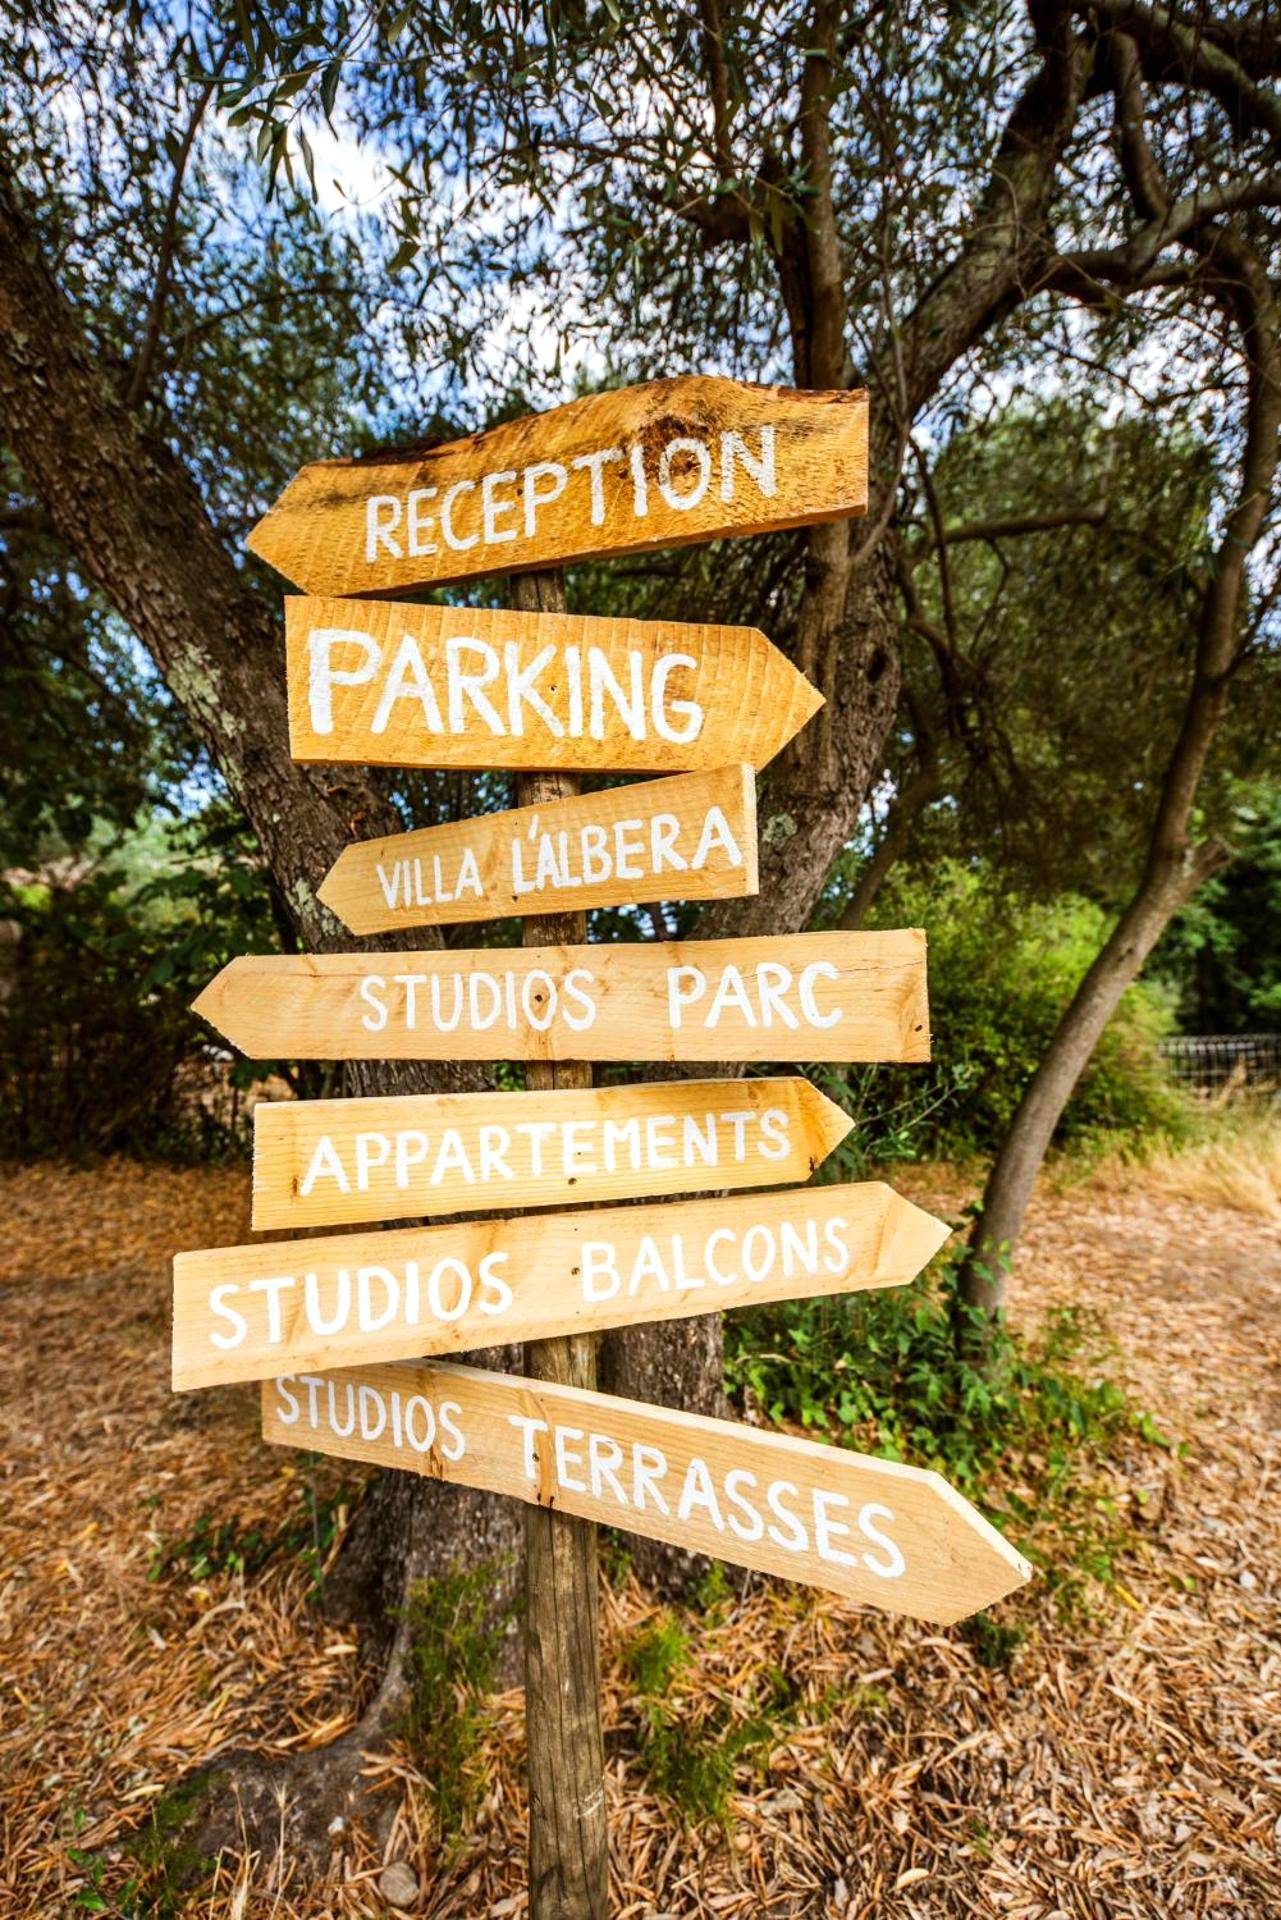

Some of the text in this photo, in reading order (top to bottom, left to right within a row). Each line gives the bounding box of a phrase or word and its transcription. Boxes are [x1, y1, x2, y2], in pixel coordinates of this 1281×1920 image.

[366, 424, 777, 562] RECEPTION
[308, 629, 704, 744] PARKING
[376, 847, 484, 909] VILLA
[360, 961, 845, 1032] STUDIOS PARC
[299, 1107, 792, 1196] APPARTEMENTS
[208, 1216, 851, 1351] STUDIOS BALCONS
[275, 1373, 906, 1580] STUDIOS TERRASSES
